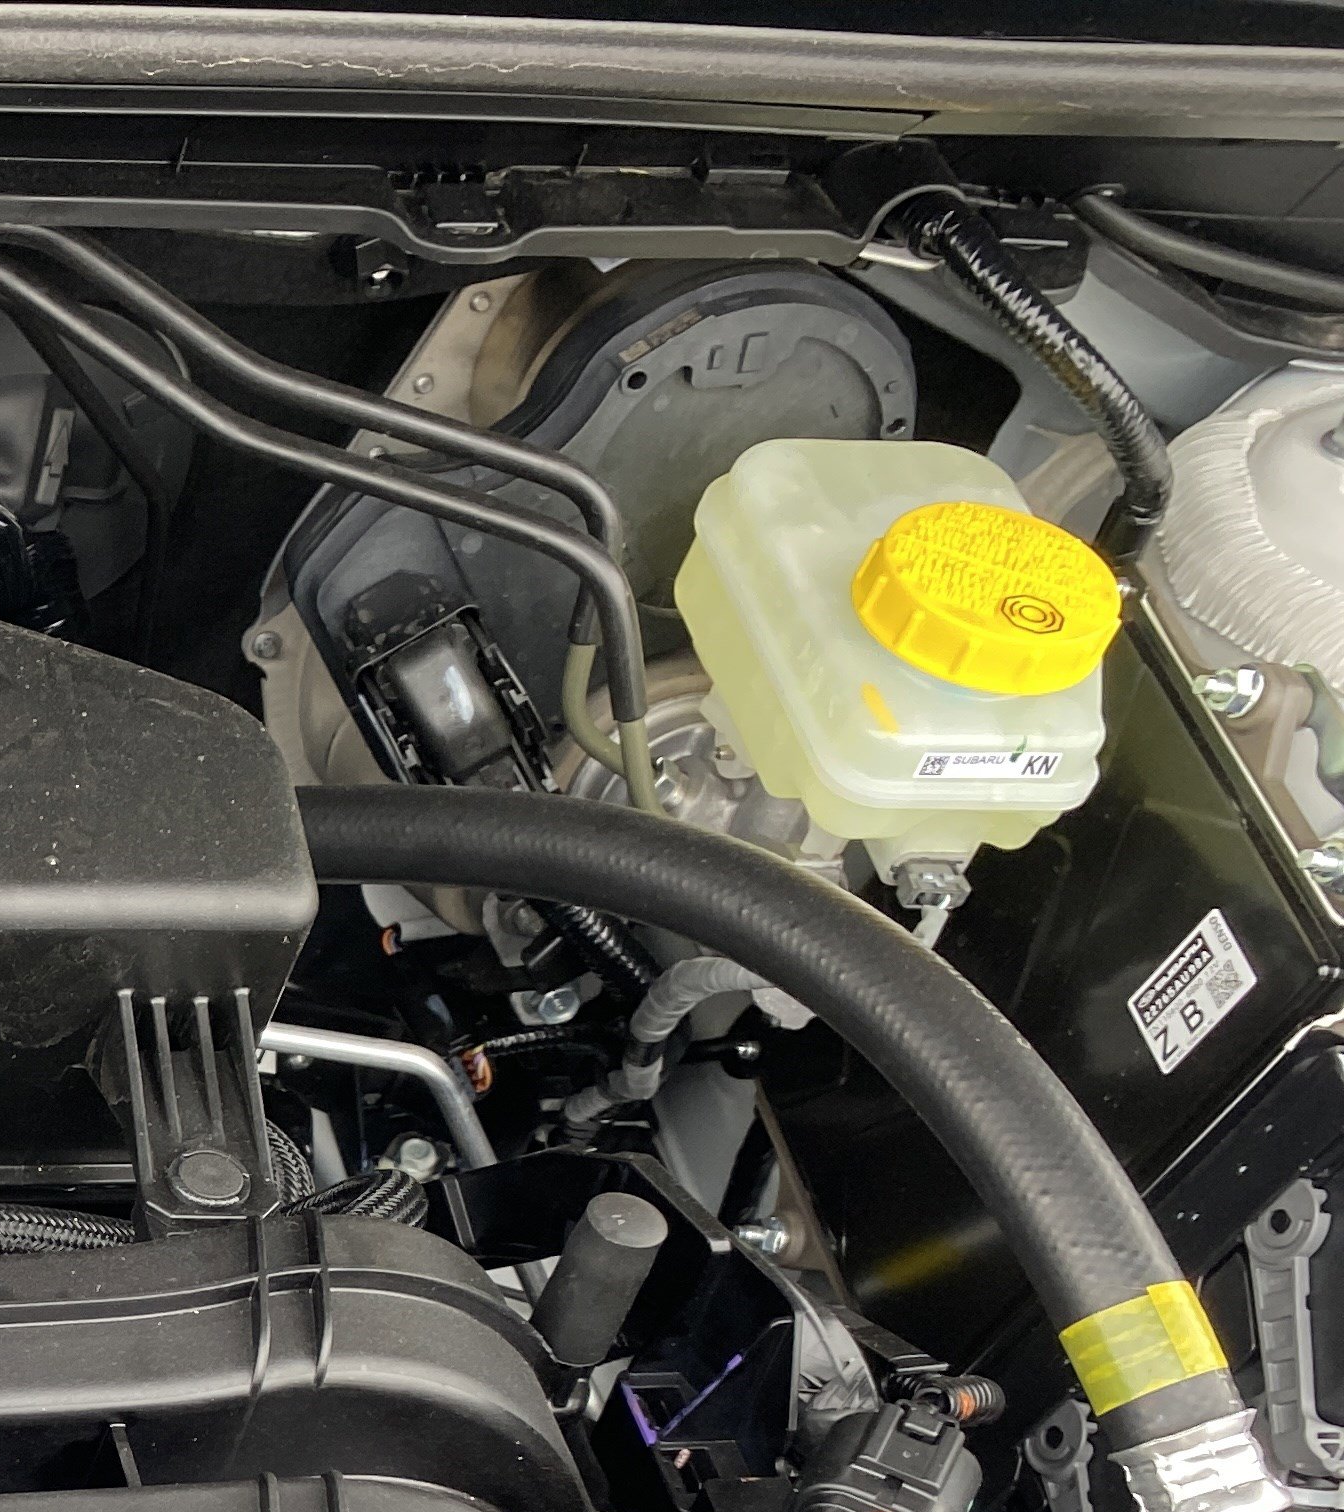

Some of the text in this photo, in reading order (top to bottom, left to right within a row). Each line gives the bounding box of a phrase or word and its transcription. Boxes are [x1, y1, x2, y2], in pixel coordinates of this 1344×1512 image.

[952, 754, 1058, 776] SUBARU KN
[1209, 916, 1232, 951] DENSO
[1154, 1028, 1180, 1061] Z
[1180, 998, 1205, 1033] B
